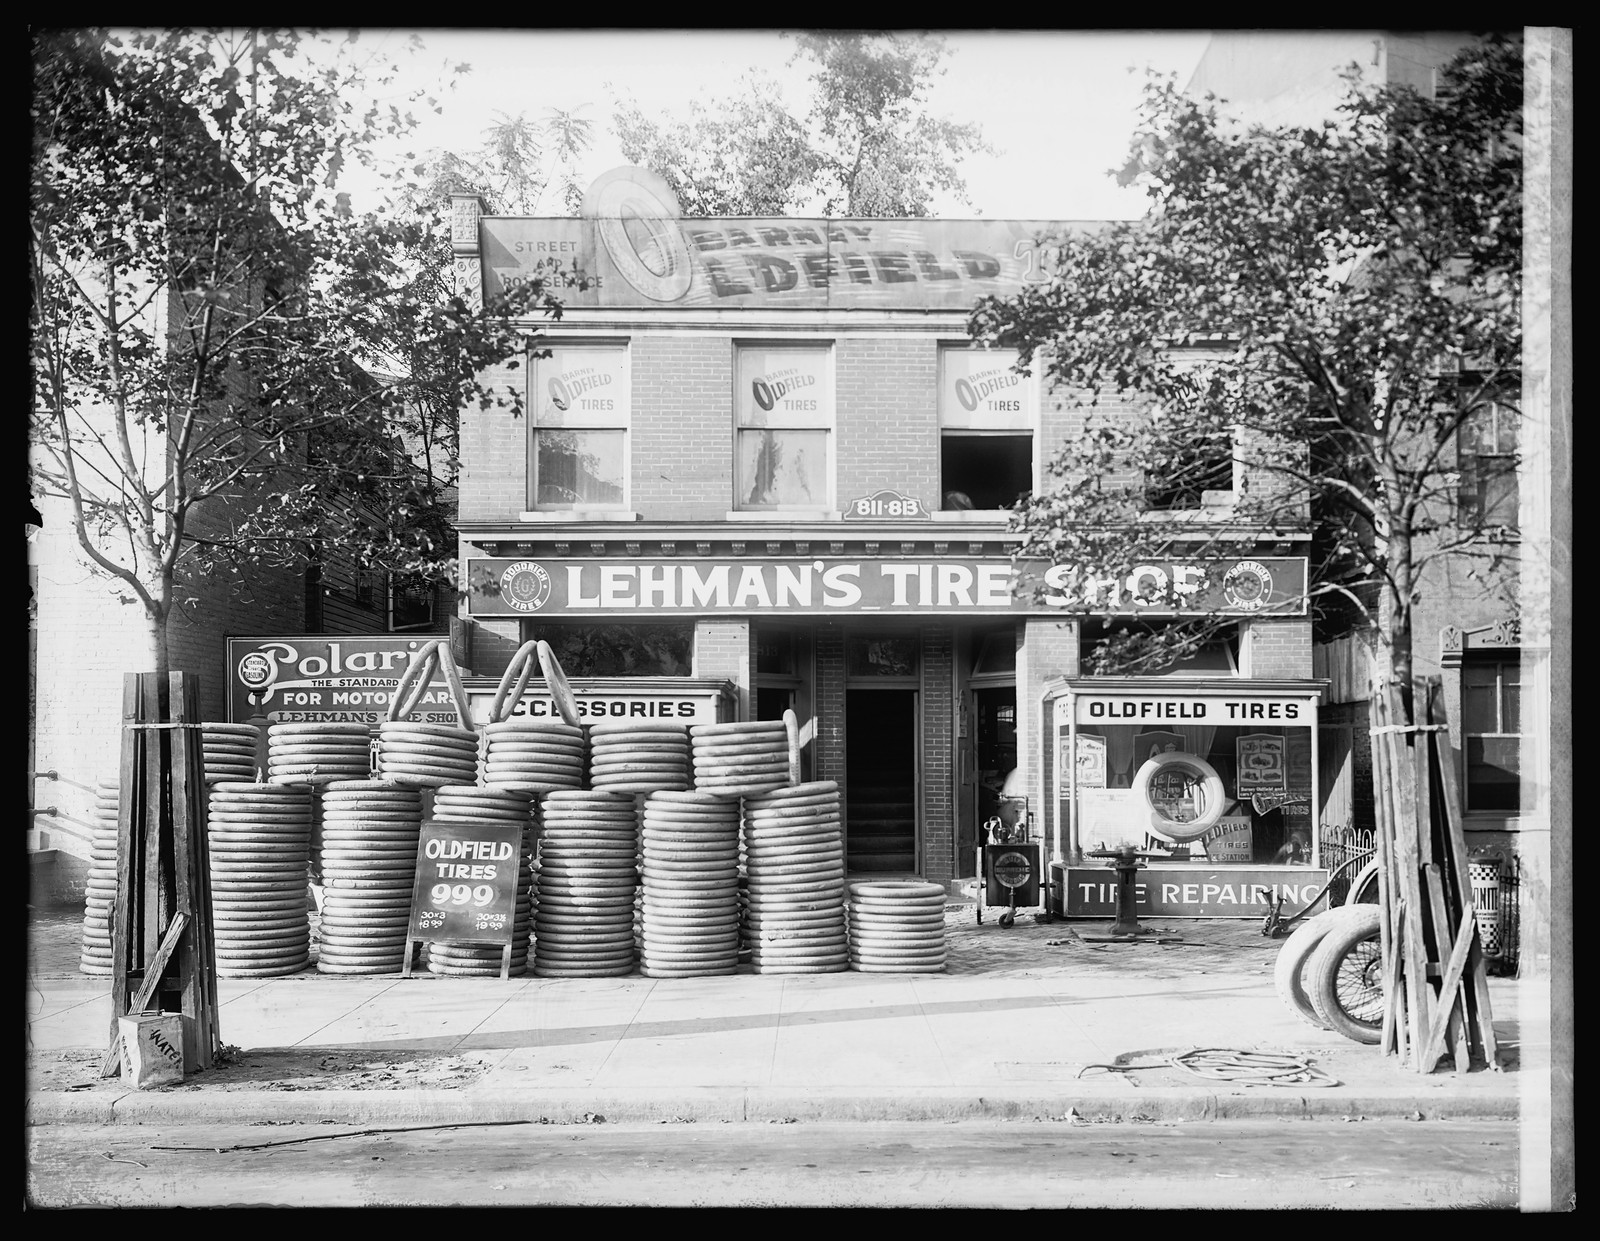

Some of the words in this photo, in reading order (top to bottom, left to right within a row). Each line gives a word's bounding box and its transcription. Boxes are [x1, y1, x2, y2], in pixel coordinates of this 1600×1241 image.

[515, 241, 577, 252] STREET
[561, 368, 595, 382] BARNEY
[765, 368, 798, 382] BARNEY
[968, 369, 1001, 383] BARNEY
[547, 373, 612, 411] OLDFIELD
[752, 375, 816, 411] OLDFIELD
[955, 376, 1019, 411] OLDFIELD
[580, 399, 614, 411] TIRES
[784, 400, 817, 411] TIRES
[988, 400, 1020, 411] TIRES
[503, 562, 548, 582] GOODRICH
[565, 560, 862, 608] LEHMAN'S
[881, 564, 1012, 606] TIRE
[510, 598, 542, 610] TIRES
[339, 679, 399, 687] STANDARD
[283, 692, 322, 705] FOR
[488, 700, 696, 717] CCESSORIES
[1089, 702, 1207, 718] OLDFIELD
[1225, 703, 1299, 719] TIRES
[277, 711, 378, 722] LEHMAN'S
[1280, 805, 1310, 815] TIRES
[1206, 823, 1248, 843] LDFIELD
[425, 839, 513, 861] OLDFIELD
[1222, 853, 1250, 861] STATION
[436, 863, 497, 880] TIRES
[431, 884, 494, 907] 999
[1162, 884, 1320, 905] REPAIRING
